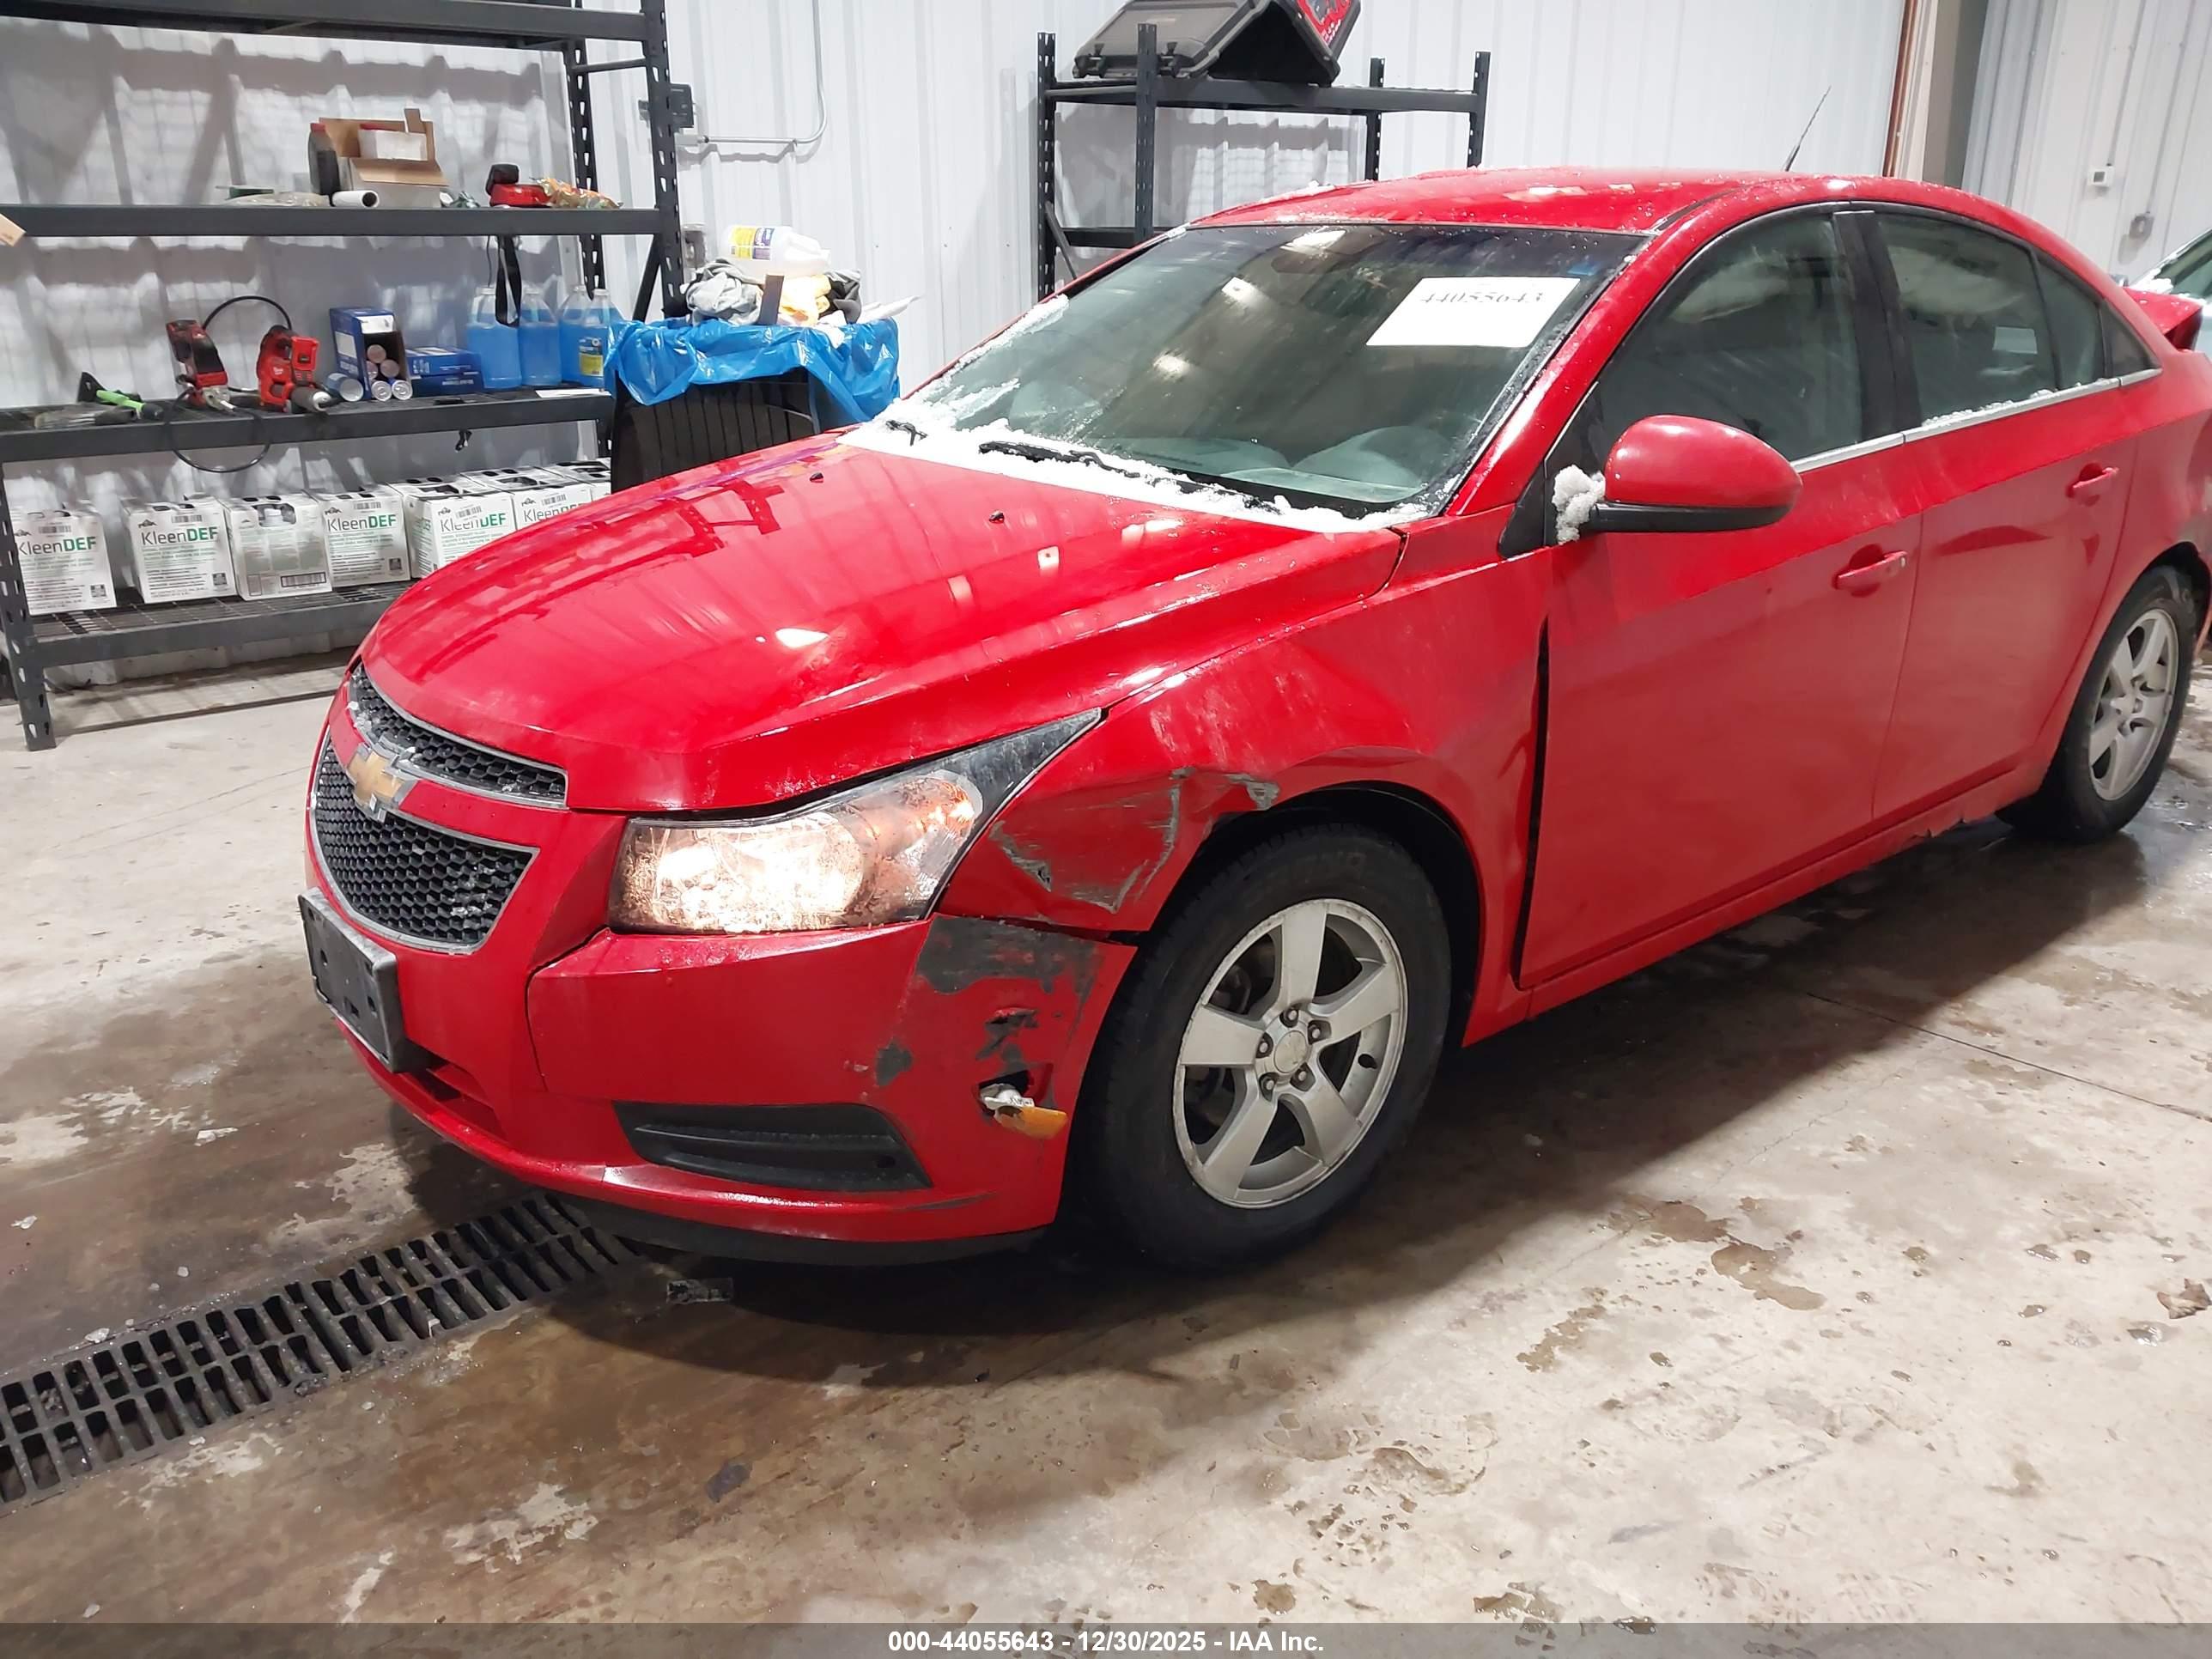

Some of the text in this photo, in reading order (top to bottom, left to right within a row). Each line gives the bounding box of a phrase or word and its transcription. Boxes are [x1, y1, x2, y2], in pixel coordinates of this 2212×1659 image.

[327, 514, 397, 532] KleenDEF
[19, 536, 97, 556] KleenDEF
[141, 526, 219, 546] KleenDEF
